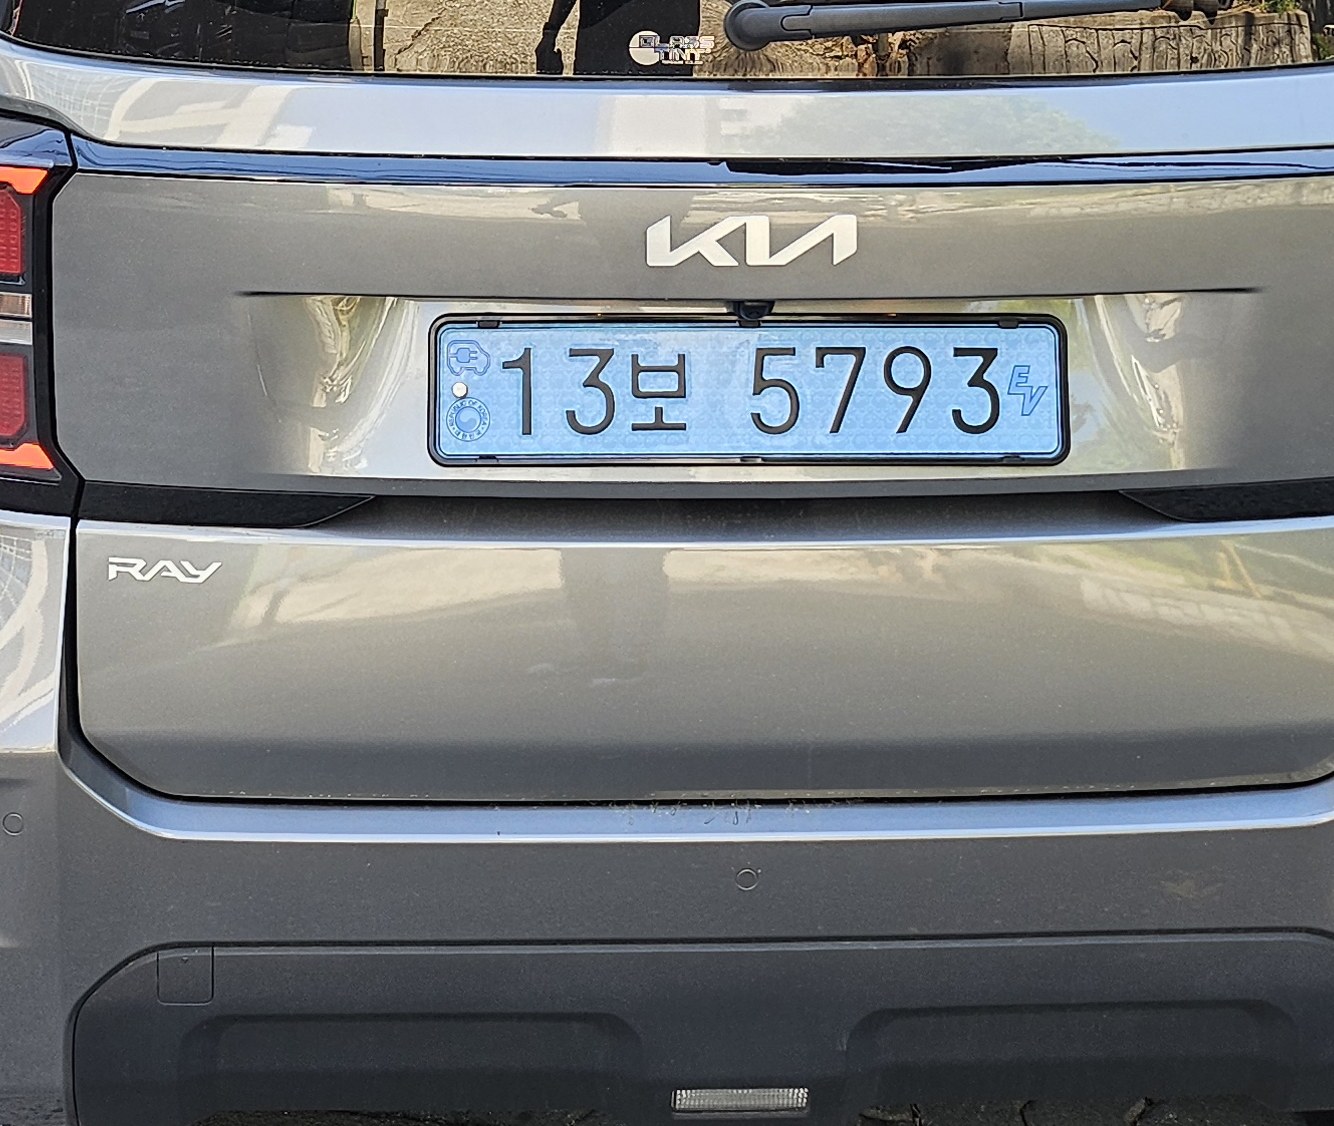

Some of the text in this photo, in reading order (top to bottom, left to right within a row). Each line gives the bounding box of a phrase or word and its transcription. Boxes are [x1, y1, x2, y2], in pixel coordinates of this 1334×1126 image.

[501, 345, 1002, 436] 13보 5793
[1008, 364, 1048, 417] EV
[108, 556, 223, 584] RAY
